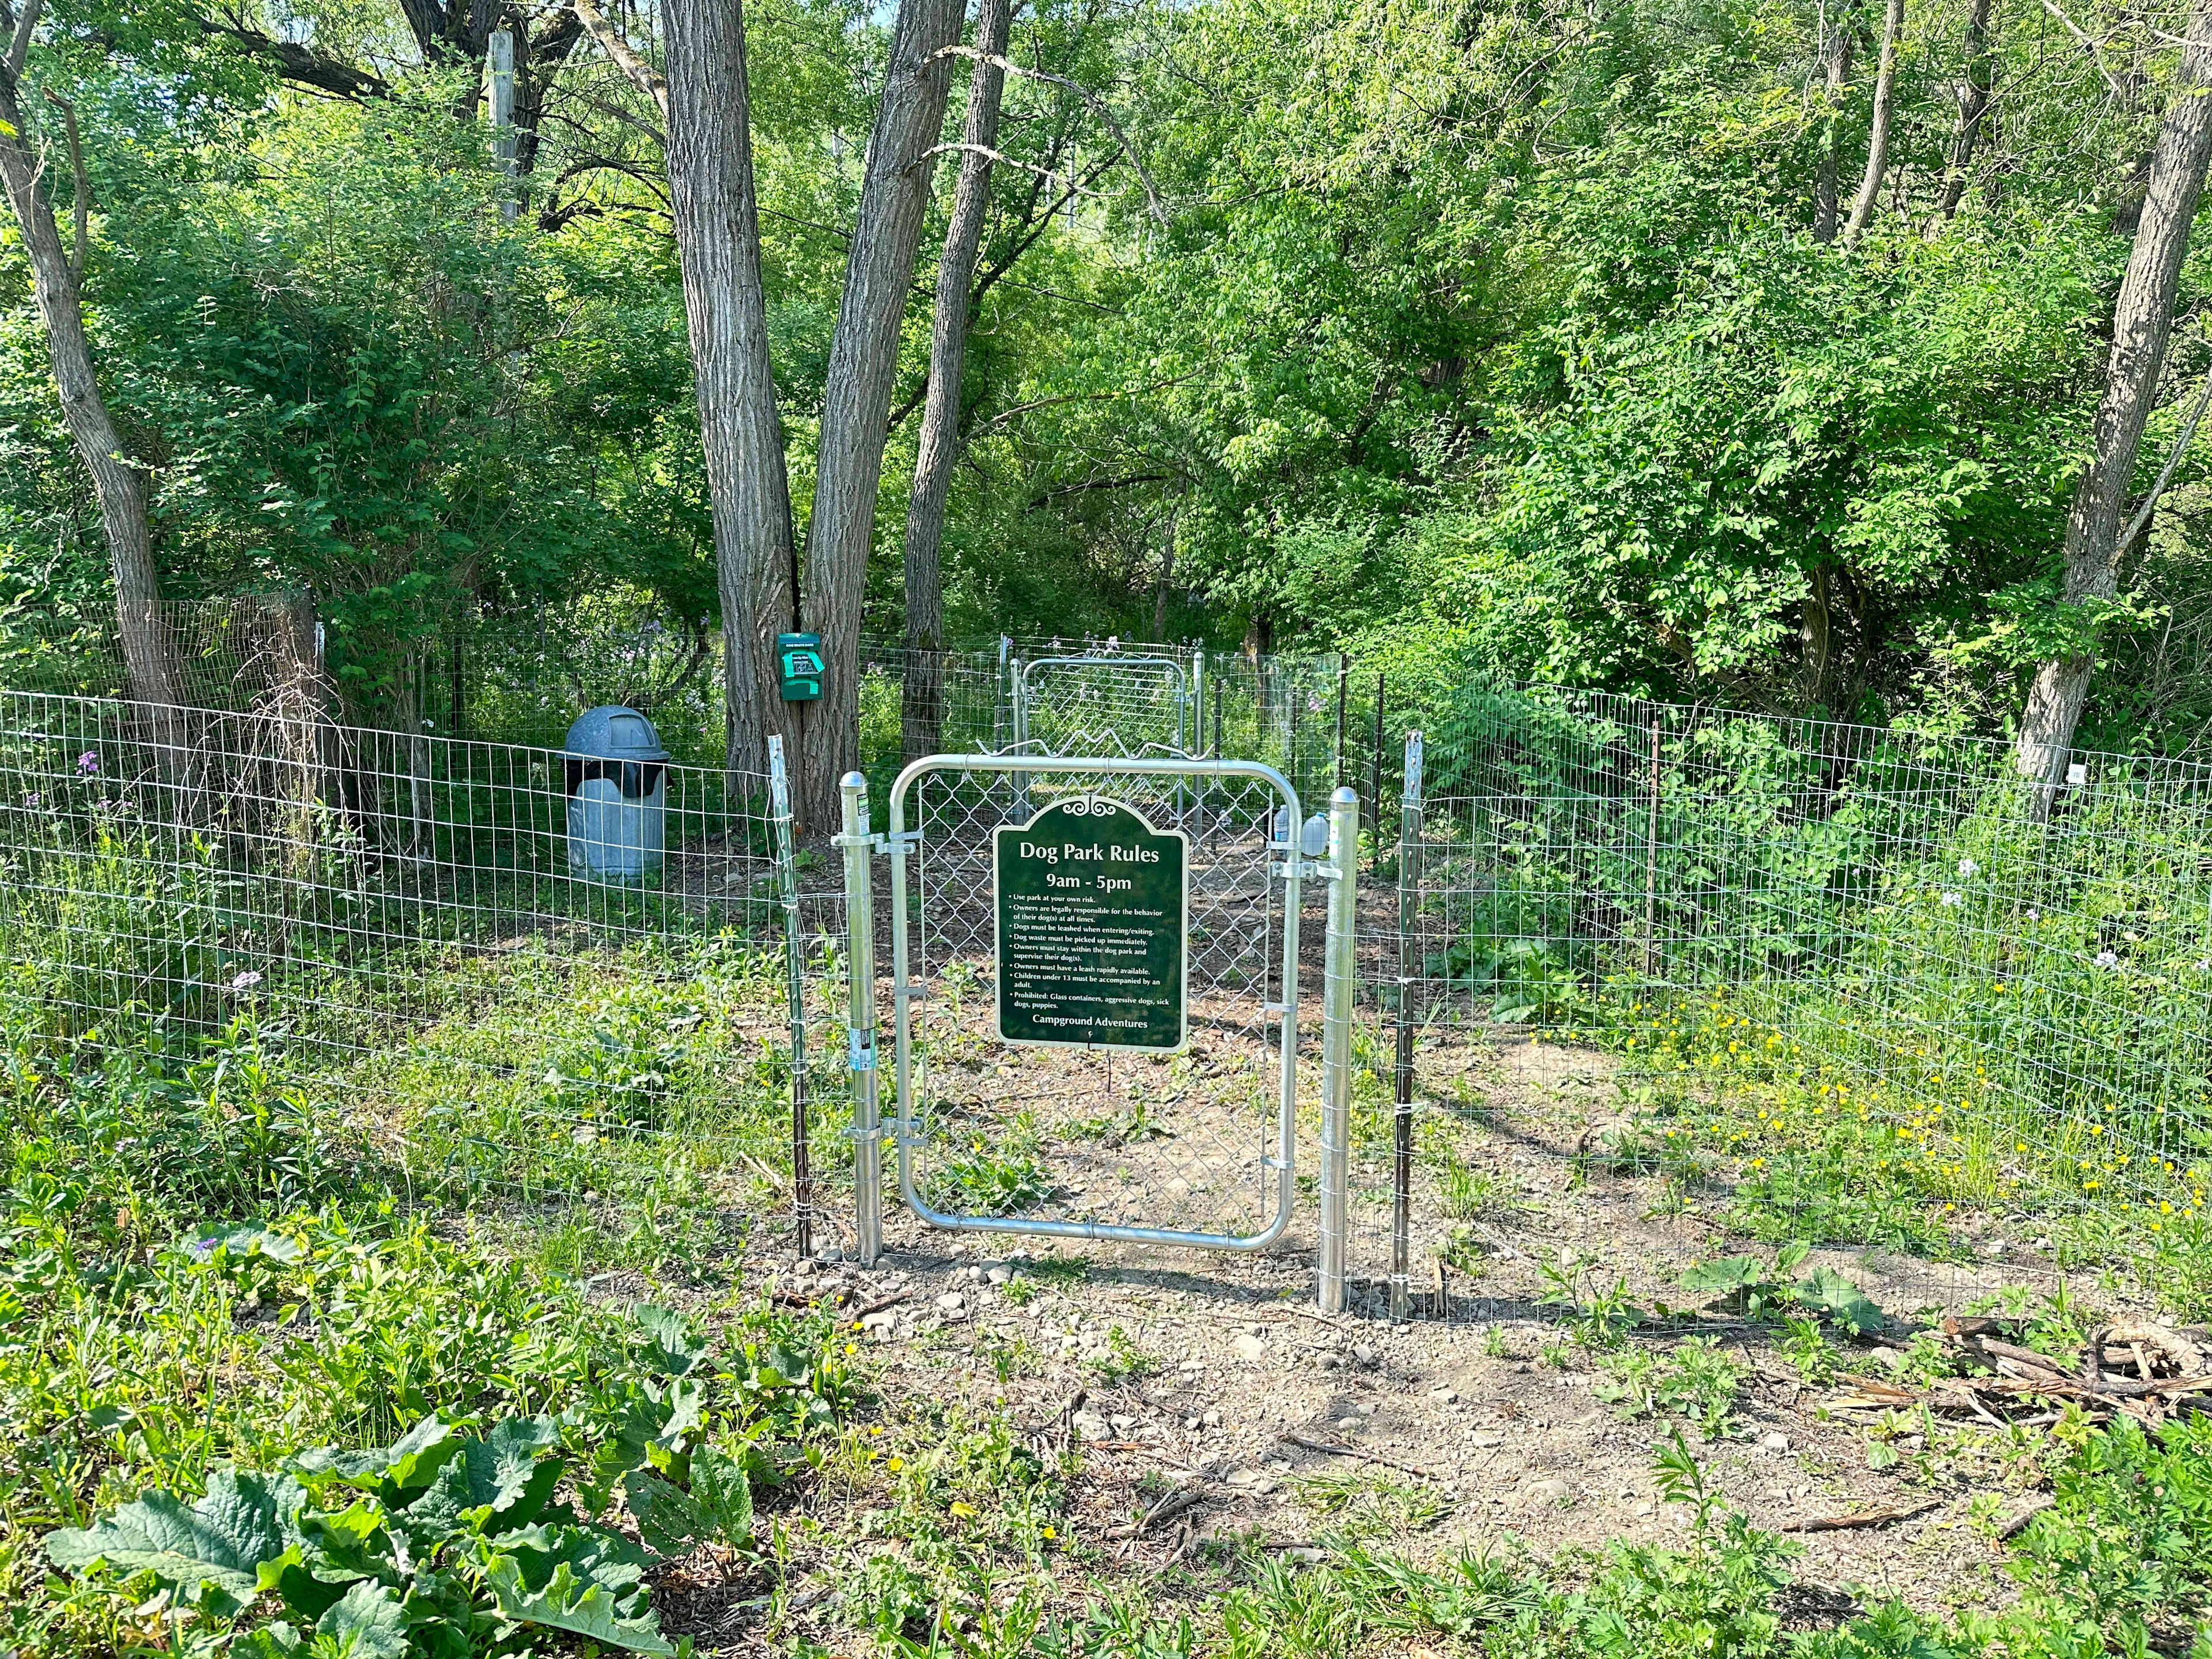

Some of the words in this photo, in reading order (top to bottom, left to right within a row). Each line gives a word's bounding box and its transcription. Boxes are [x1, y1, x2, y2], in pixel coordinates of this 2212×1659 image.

[1020, 842, 1058, 863] Dog
[1064, 843, 1104, 861] Park
[1110, 844, 1160, 863] Rules
[1046, 874, 1080, 888] 9am
[1096, 876, 1132, 893] 5pm
[1051, 906, 1072, 914] legally
[1107, 938, 1147, 946] immediately.
[1097, 967, 1119, 975] rapidly
[1069, 994, 1103, 1002] containers,
[1032, 1014, 1092, 1026] Campground
[1095, 1017, 1147, 1028] Adventures
